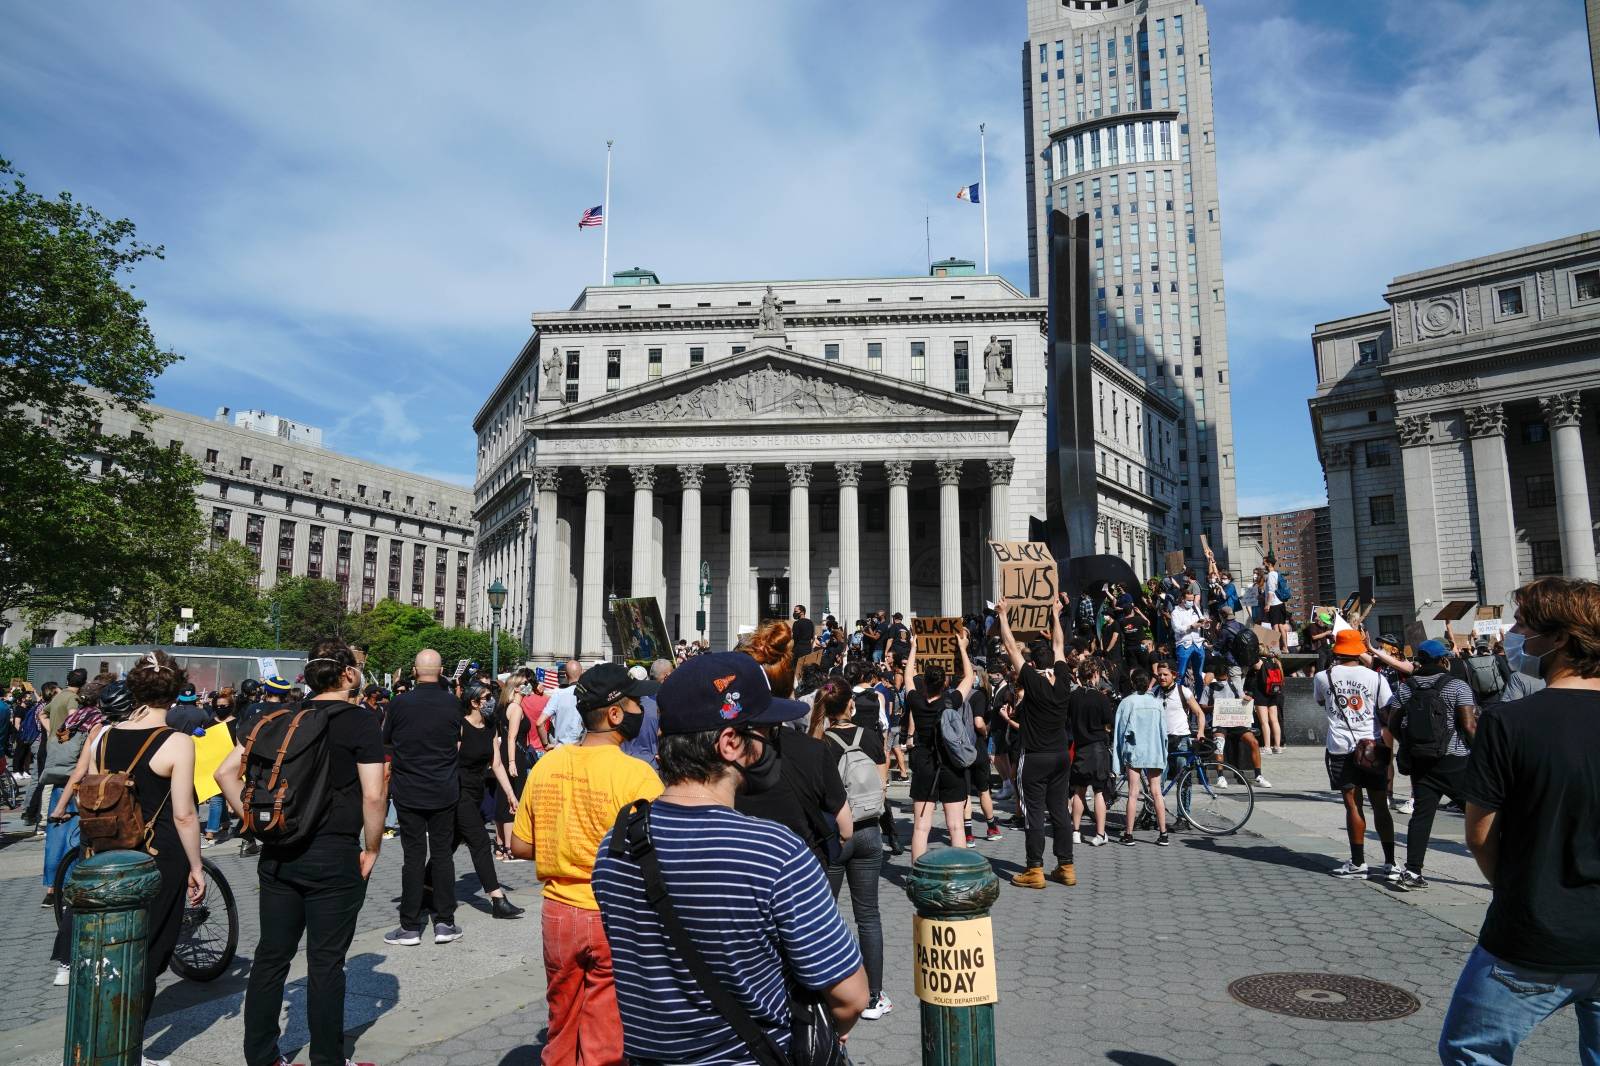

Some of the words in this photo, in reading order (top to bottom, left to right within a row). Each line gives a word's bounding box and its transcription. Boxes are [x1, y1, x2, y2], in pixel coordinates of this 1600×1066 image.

[702, 437, 744, 447] JUSTICE
[831, 435, 864, 445] PILLAR
[867, 435, 881, 445] OF
[886, 434, 918, 444] GOOD
[922, 432, 999, 443] GOVERNMENT
[992, 543, 1052, 561] BLACK
[1002, 565, 1054, 600] LIVES
[913, 618, 960, 634] BLACK
[916, 636, 958, 654] LIVES
[931, 925, 956, 947] NO
[917, 943, 985, 970] PARKING
[921, 969, 977, 994] TODAY
[934, 996, 953, 1005] POLICE
[954, 995, 990, 1005] DEPARTMENT
